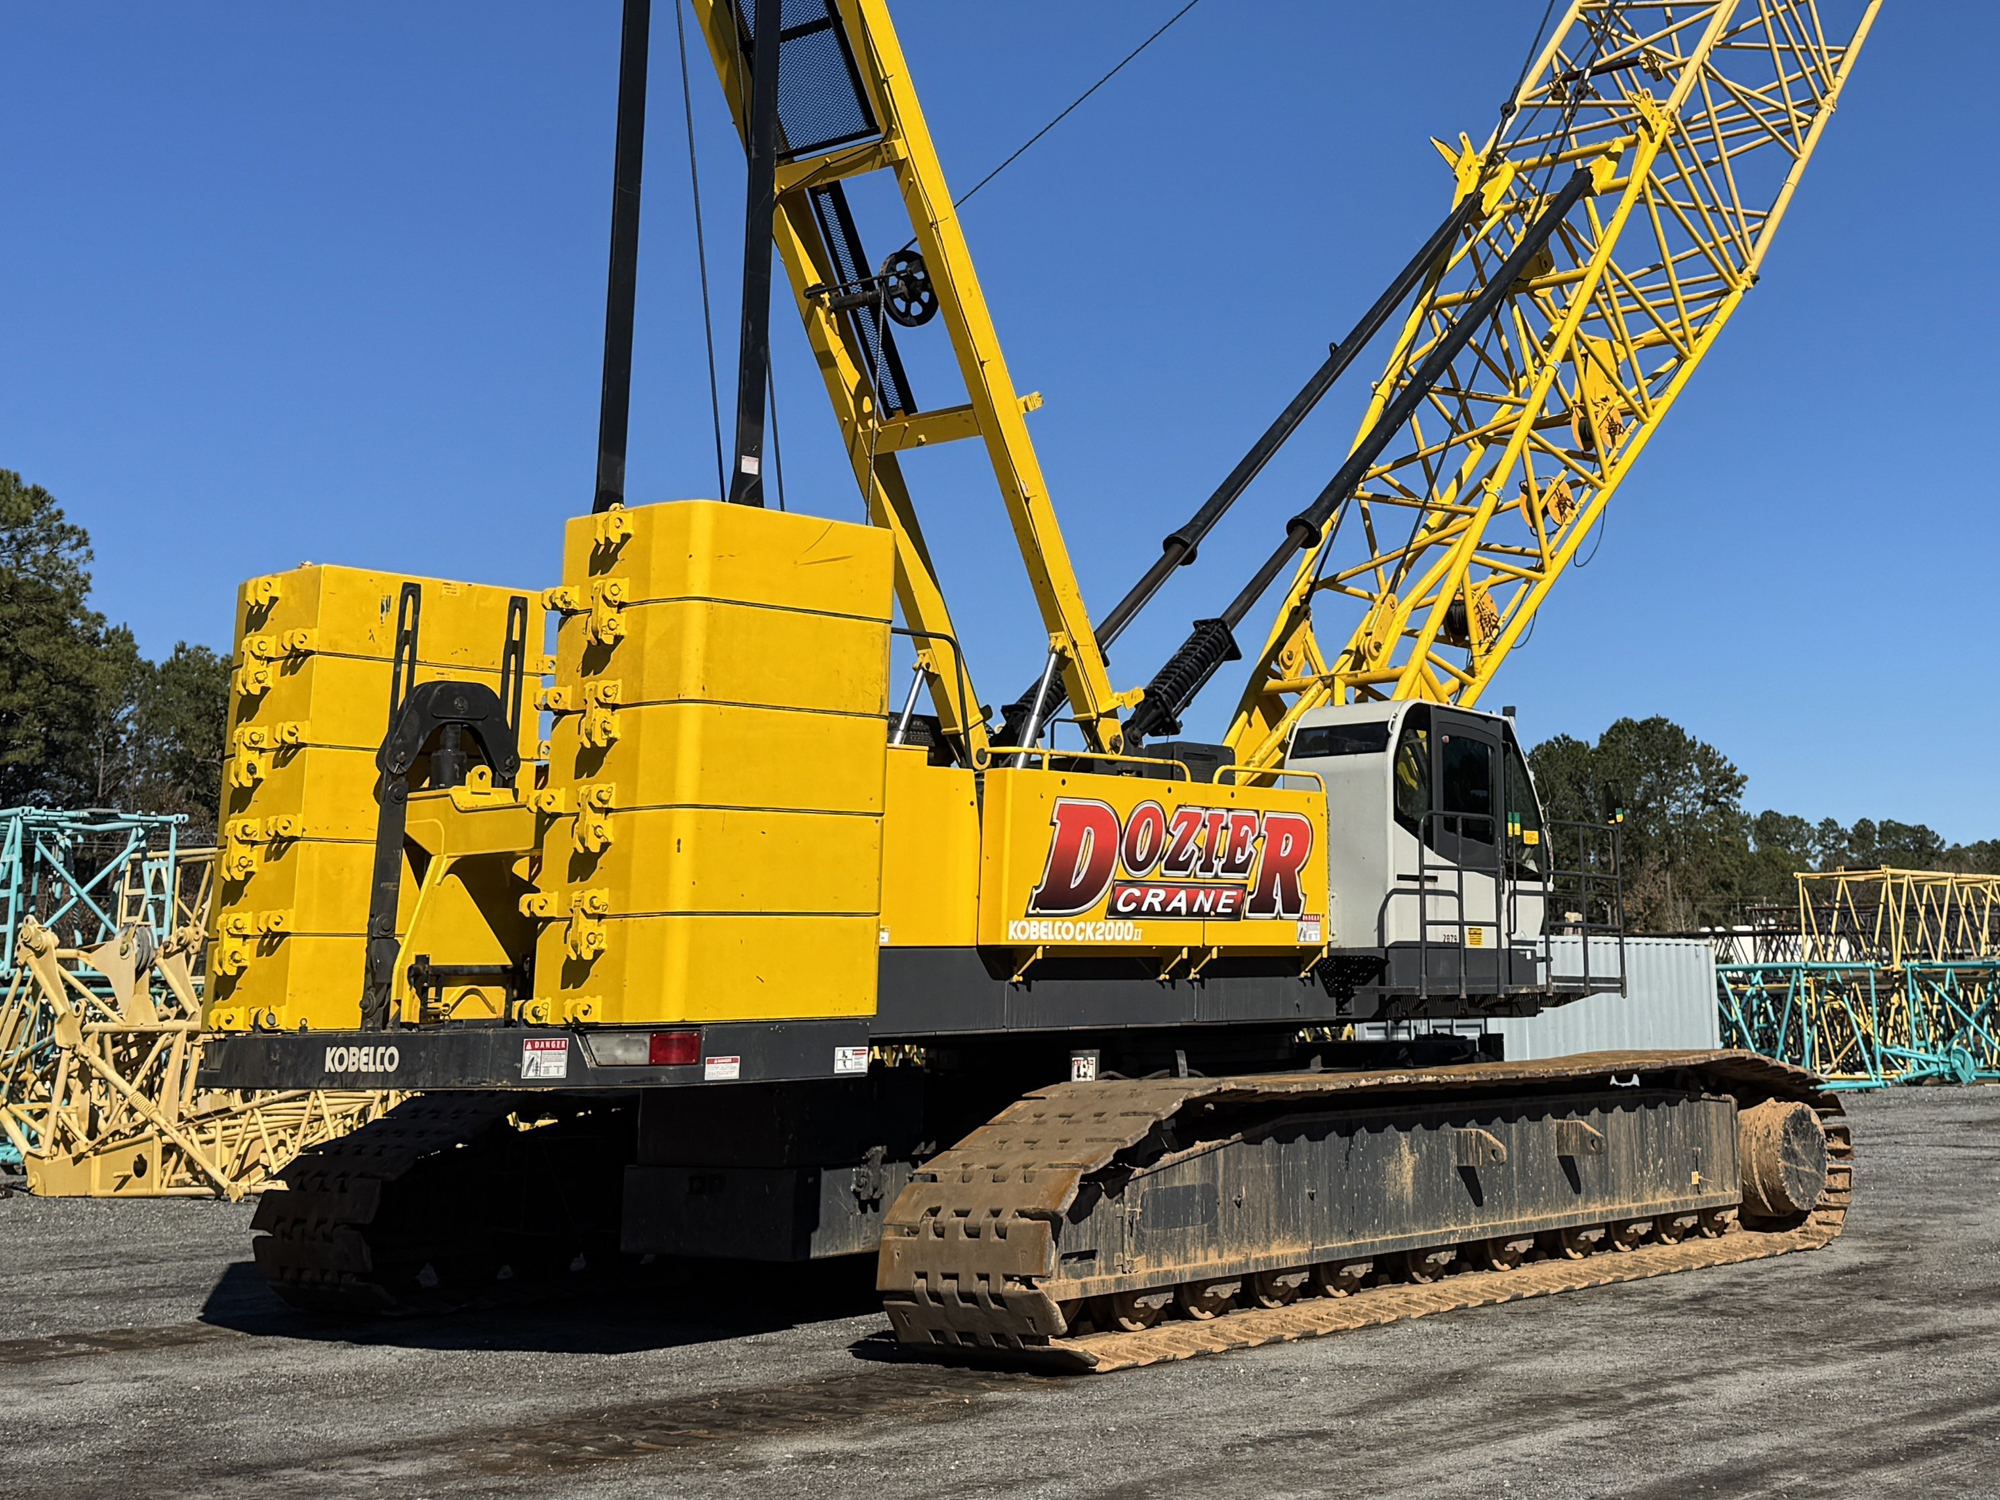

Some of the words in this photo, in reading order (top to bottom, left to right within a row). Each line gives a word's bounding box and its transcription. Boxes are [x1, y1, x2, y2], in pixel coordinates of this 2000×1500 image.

[1024, 797, 1313, 920] DOZIER
[1116, 888, 1237, 915] CRANE
[534, 1041, 566, 1049] DANGER
[324, 1046, 399, 1072] KOBELCO
